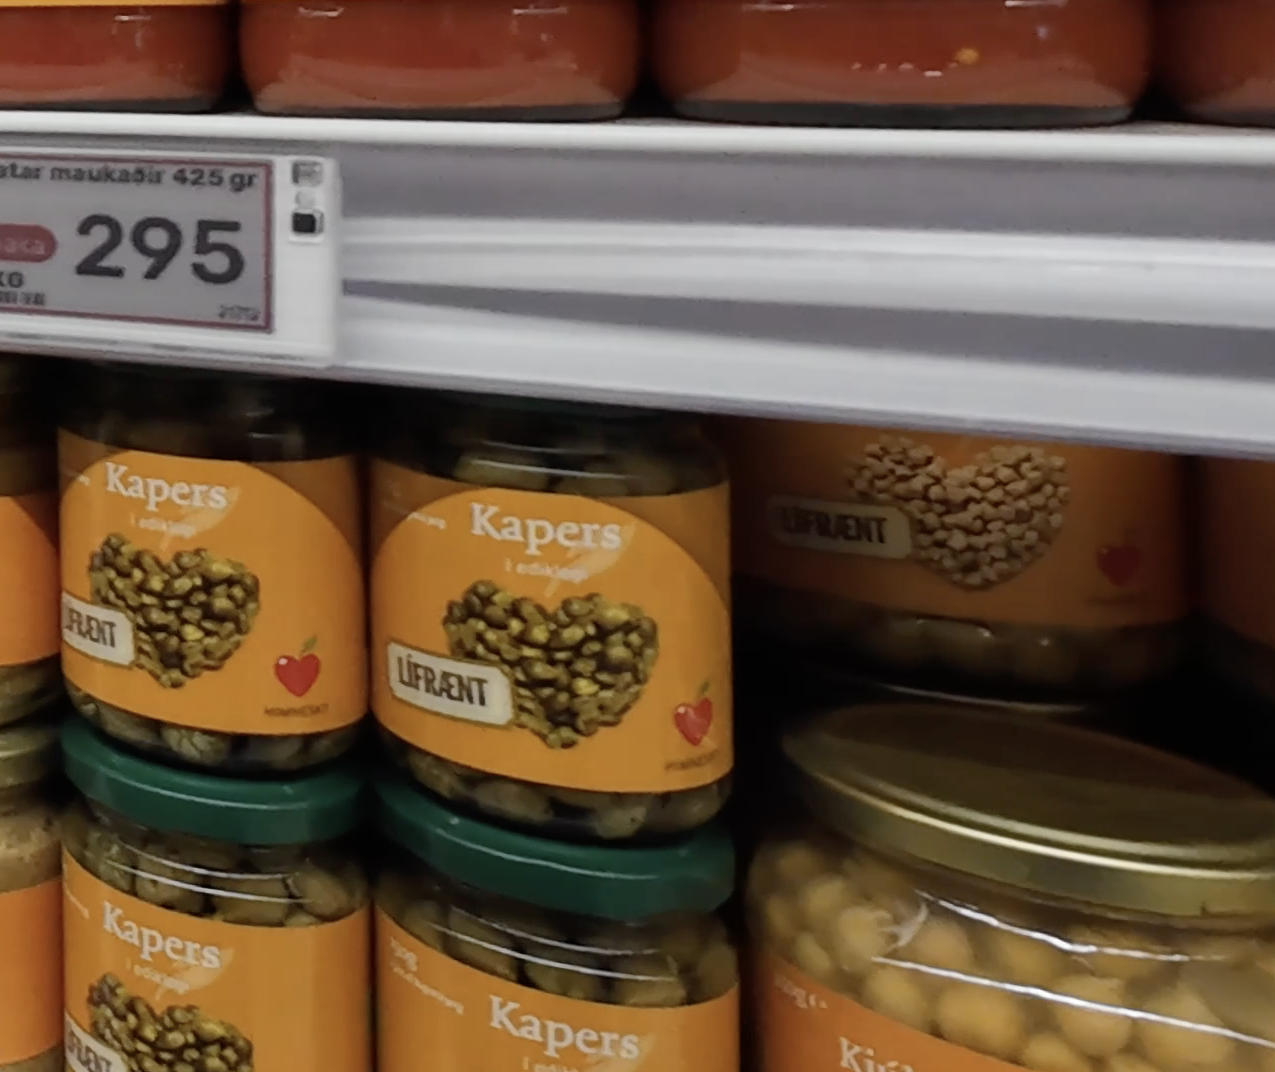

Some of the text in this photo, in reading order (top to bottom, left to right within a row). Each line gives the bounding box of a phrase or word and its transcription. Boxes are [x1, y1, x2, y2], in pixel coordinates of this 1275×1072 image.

[172, 167, 225, 187] 425
[229, 172, 258, 194] gr
[74, 213, 246, 286] 295
[104, 461, 229, 512] Kapers
[469, 502, 622, 557] Kapers
[396, 654, 490, 708] LÍFRÆNT
[102, 899, 222, 970] Kapers
[488, 993, 640, 1061] Kapers
